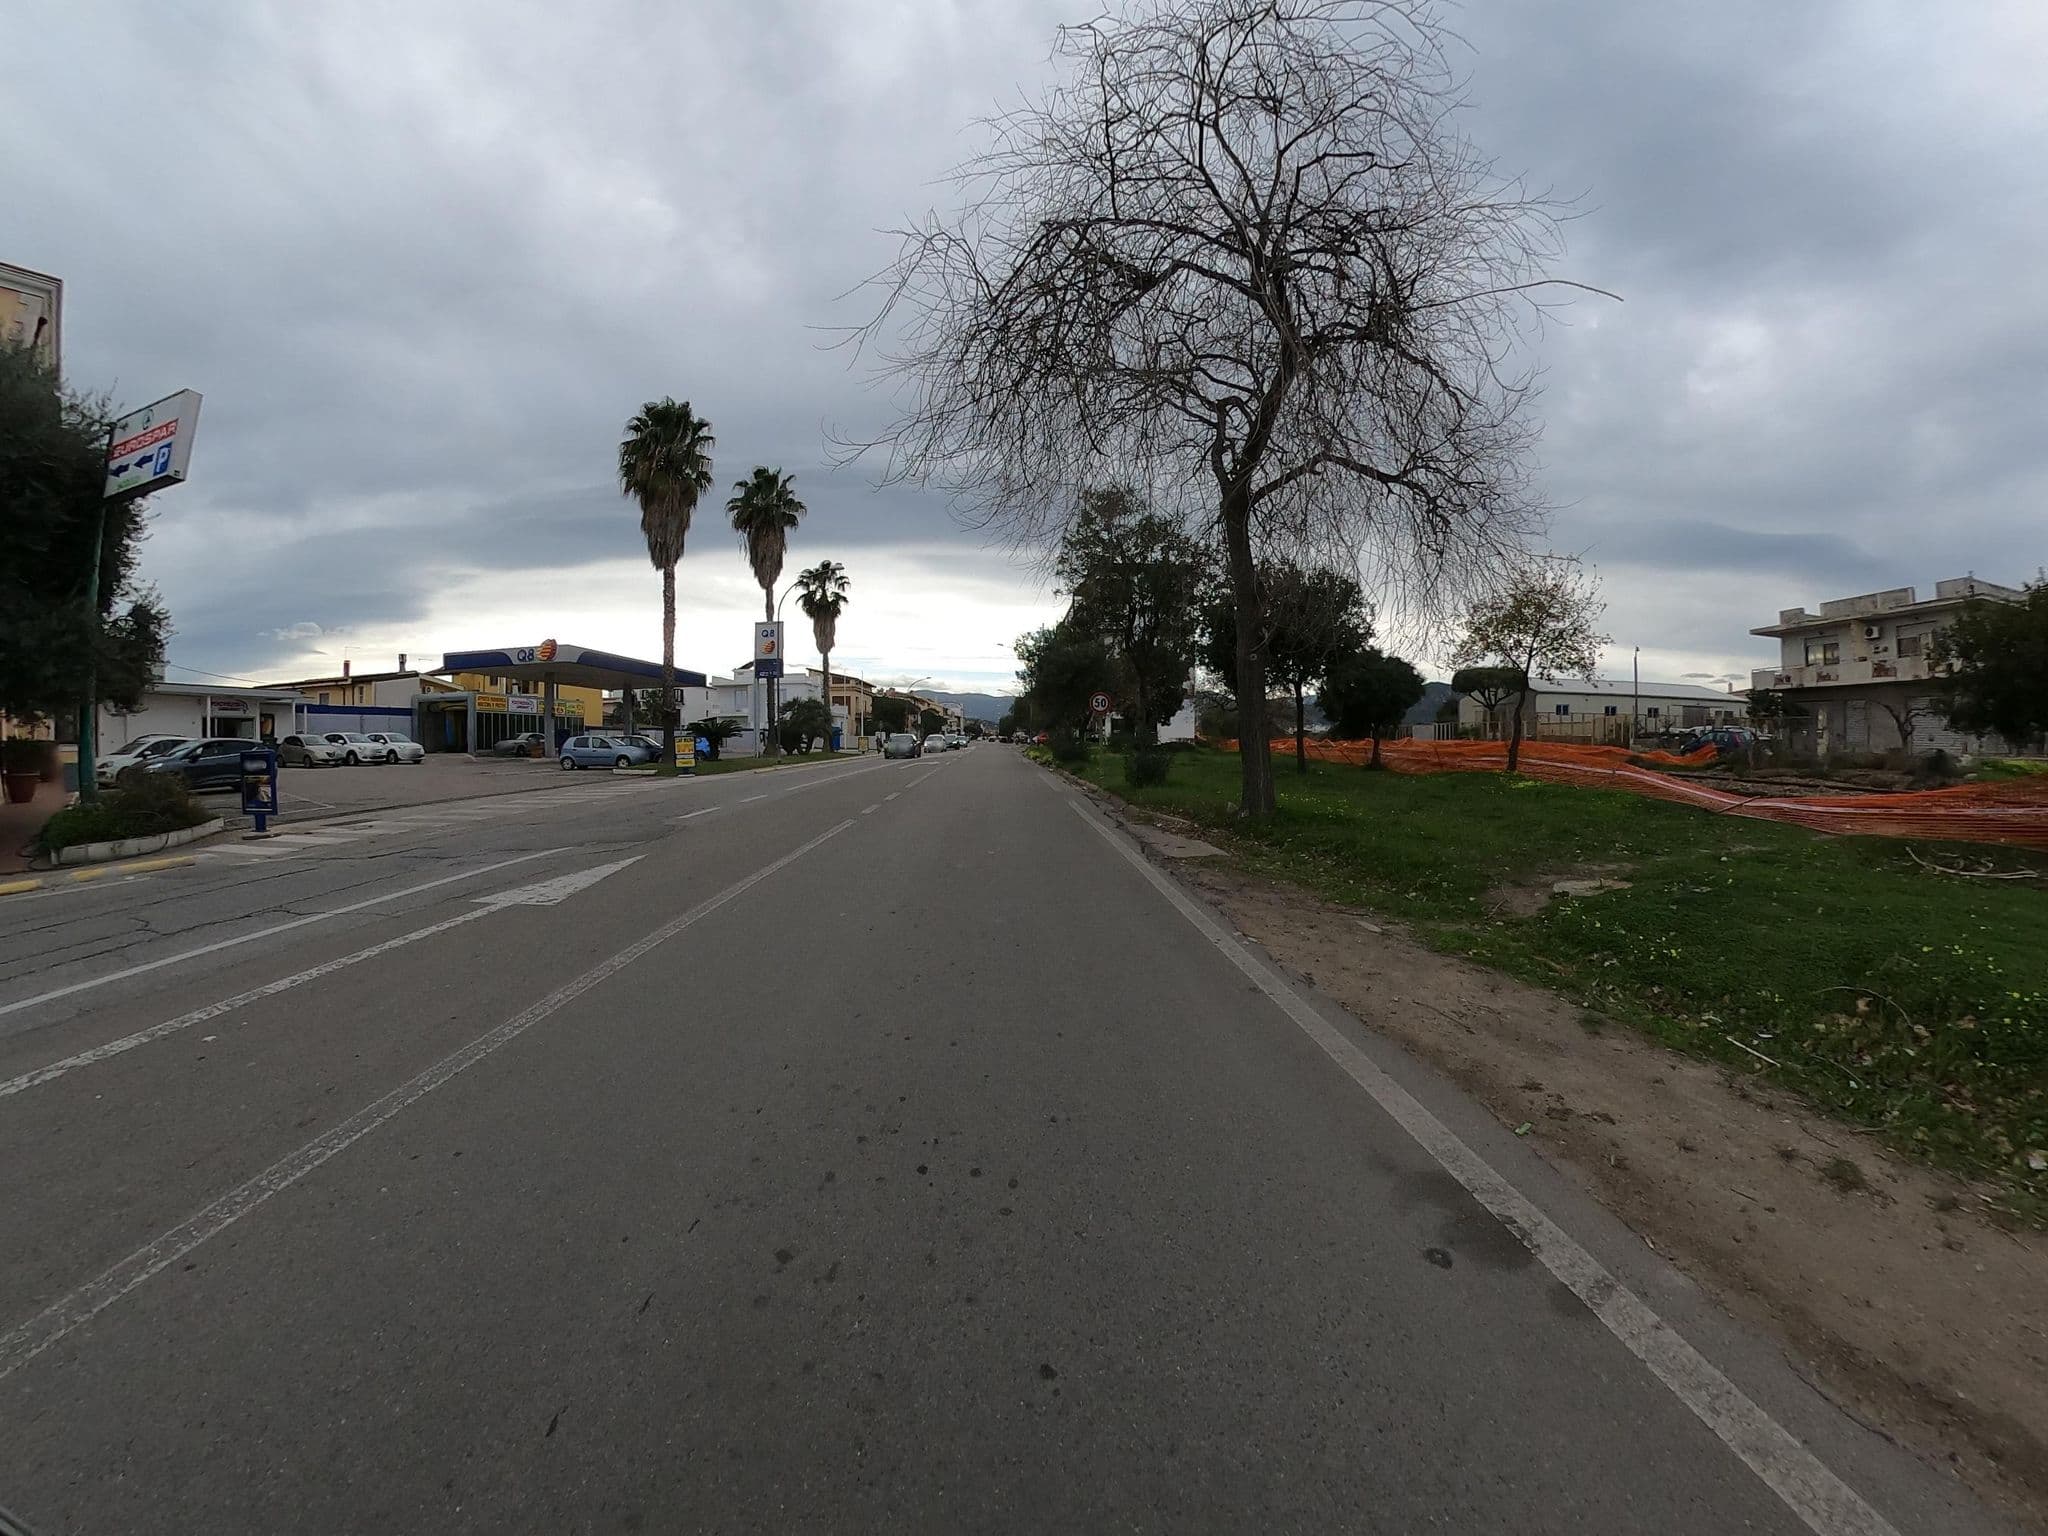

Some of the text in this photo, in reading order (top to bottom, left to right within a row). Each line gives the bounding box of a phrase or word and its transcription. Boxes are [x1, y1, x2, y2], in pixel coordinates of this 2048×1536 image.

[156, 447, 170, 473] P
[761, 629, 775, 638] Q8
[517, 648, 534, 662] Q8
[1095, 698, 1106, 708] 50
